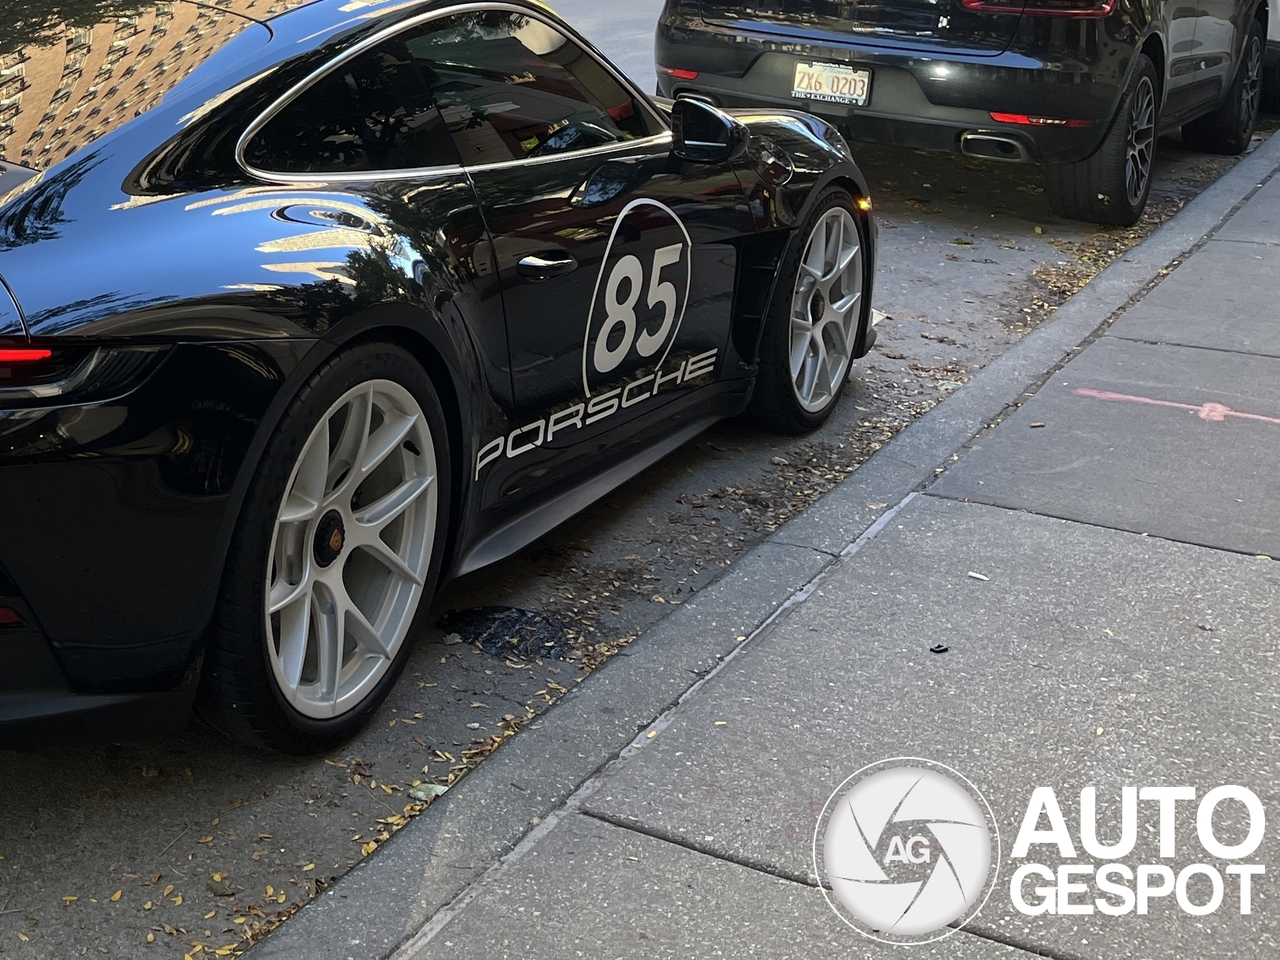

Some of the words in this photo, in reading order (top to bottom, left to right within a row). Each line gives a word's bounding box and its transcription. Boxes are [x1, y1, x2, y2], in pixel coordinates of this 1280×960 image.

[797, 72, 823, 91] ZX6
[831, 76, 866, 97] 0203
[811, 93, 851, 103] EXCHANGE
[593, 242, 683, 373] 85
[474, 348, 718, 481] PORSCHE
